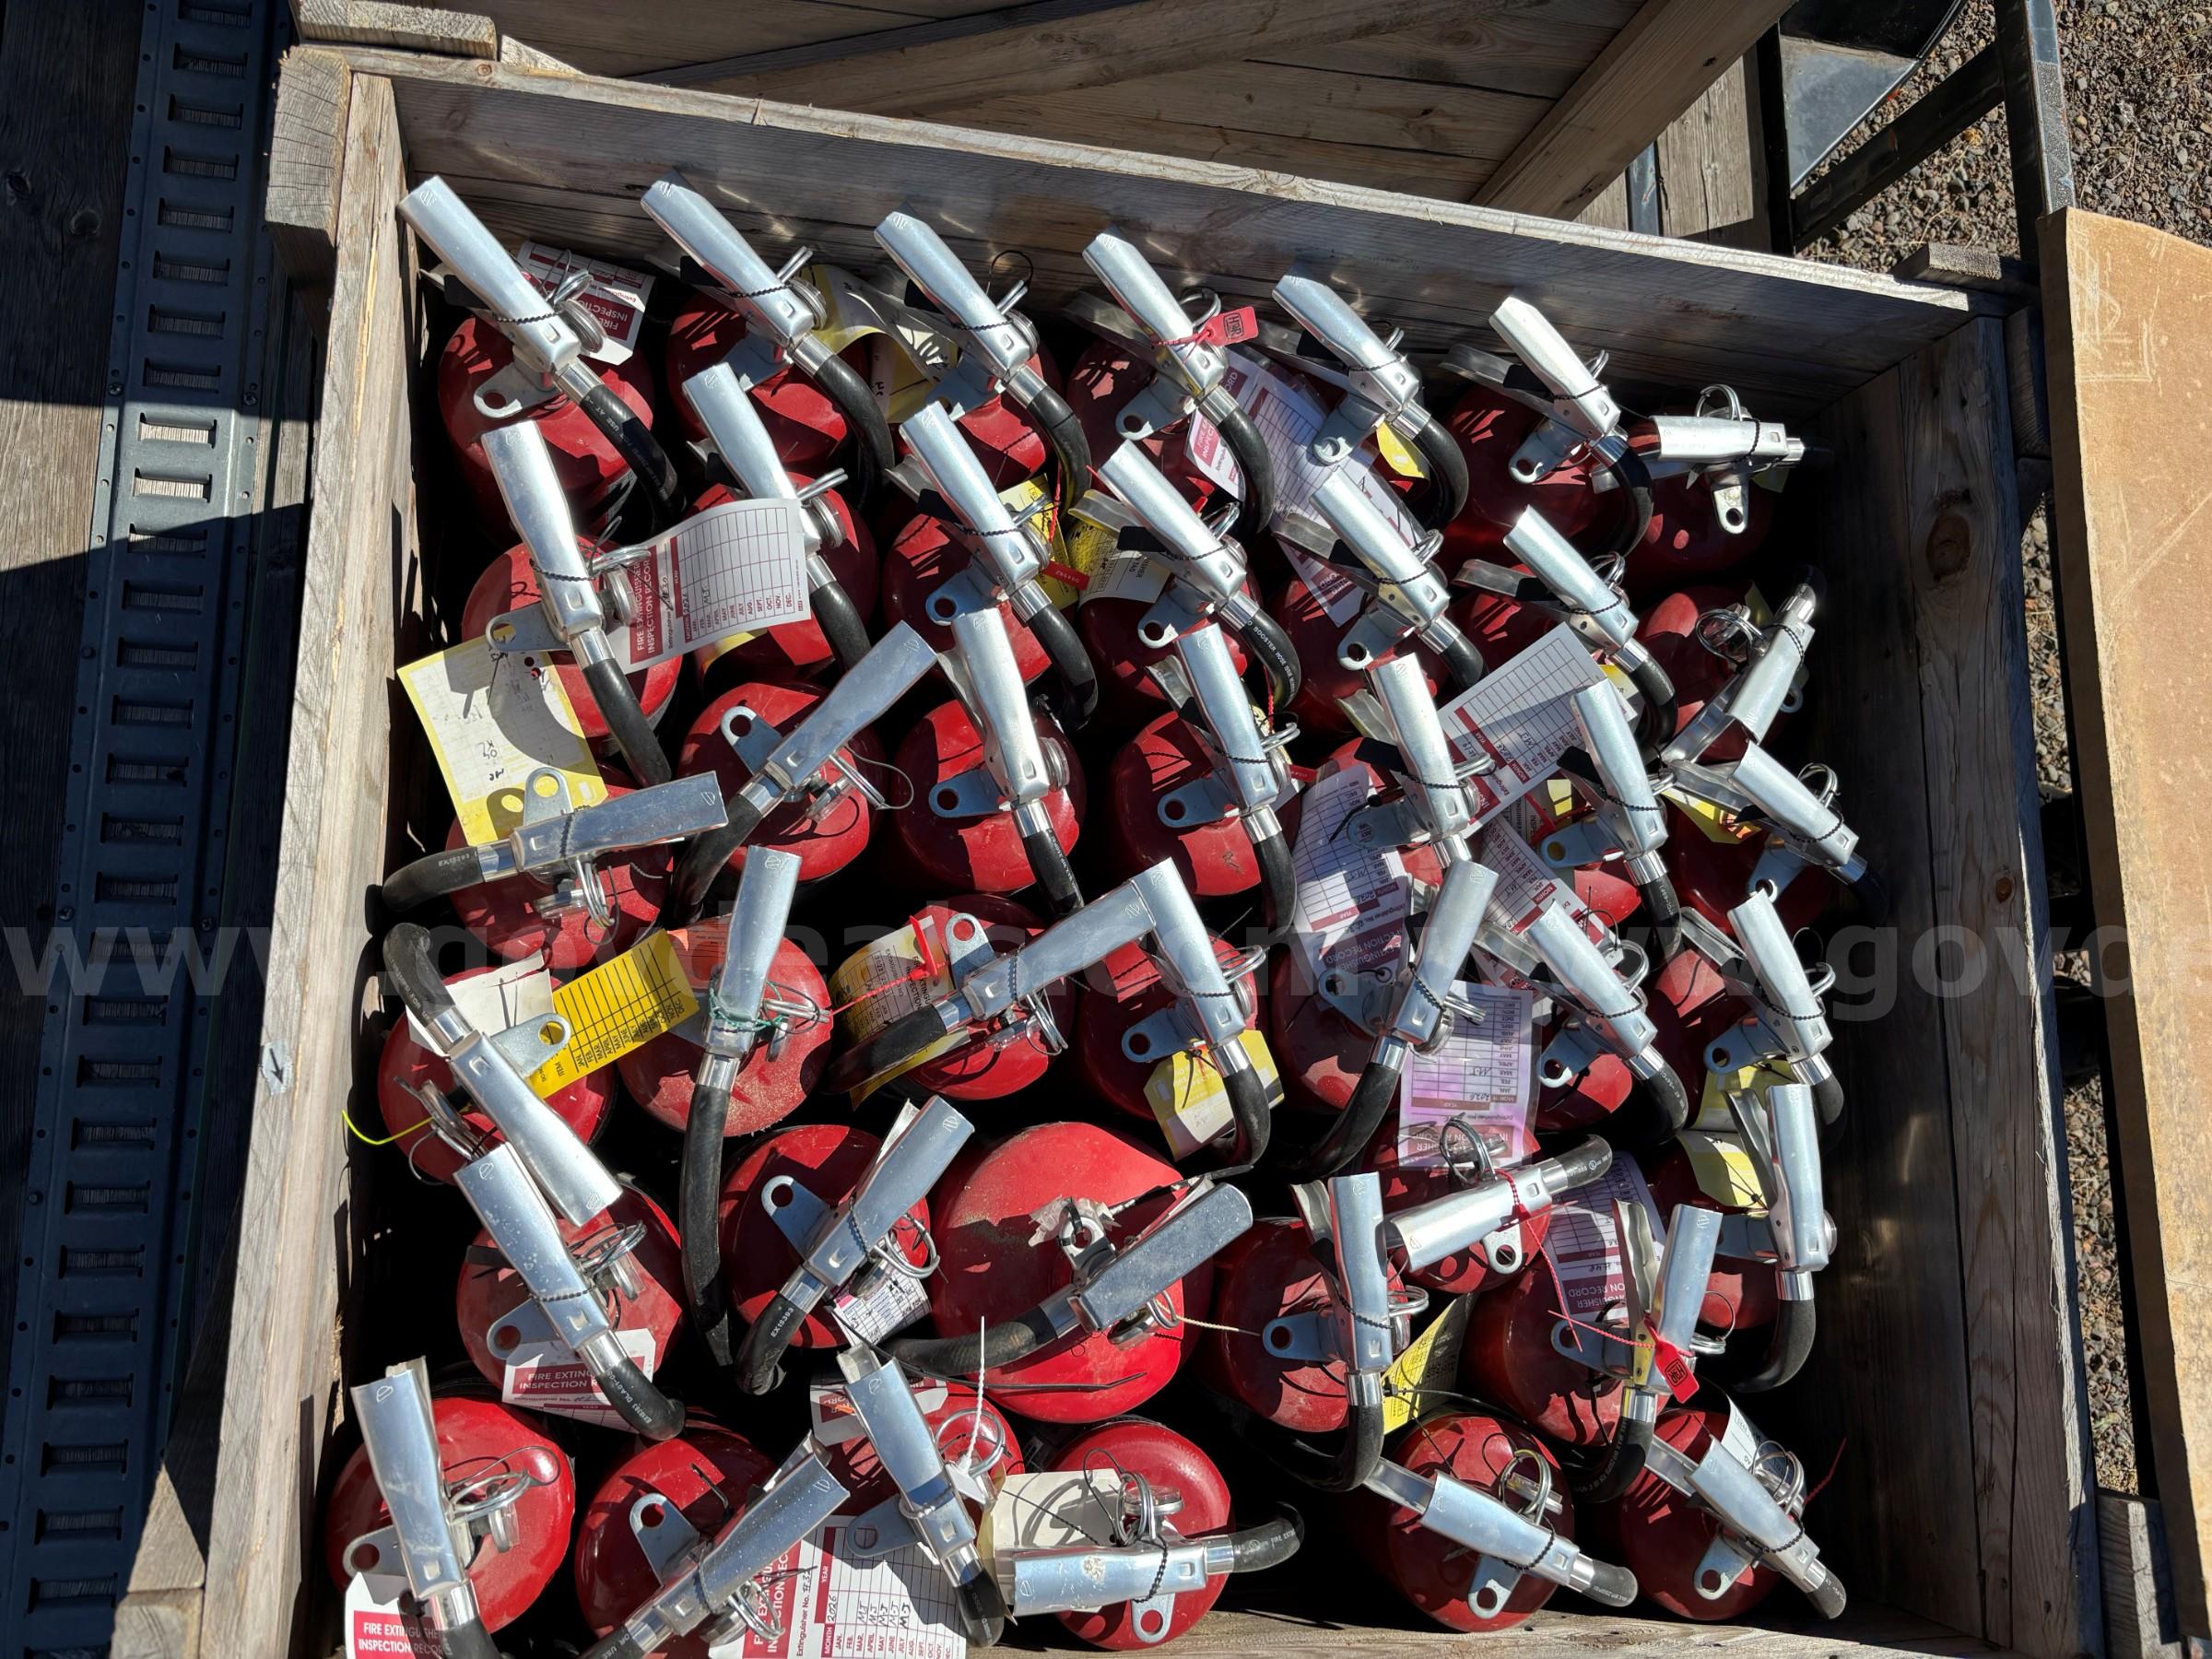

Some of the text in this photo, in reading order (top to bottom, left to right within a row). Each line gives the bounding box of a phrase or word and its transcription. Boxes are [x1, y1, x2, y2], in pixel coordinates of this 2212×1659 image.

[575, 299, 628, 322] INSPECTIO
[642, 559, 655, 653] INSPECTION RECOR
[746, 599, 754, 615] AUG.
[784, 592, 793, 607] DEC.
[635, 630, 646, 651] FIRE
[1252, 625, 1277, 653] BOOSTER
[1567, 1283, 1606, 1298] RECORD
[520, 1379, 587, 1389] INSPECTION
[527, 1370, 592, 1381] FIRE EXTING
[819, 1564, 830, 1583] YEAR
[825, 1594, 839, 1622] 2026
[363, 1622, 439, 1639] FIRE EXTINGUSHE
[795, 1593, 810, 1657] Extinguisher No.
[358, 1638, 443, 1655] INSPECTION RECOR
[822, 1626, 832, 1654] MONTH
[833, 1632, 843, 1650] JAN.
[844, 1633, 853, 1649] FEB.
[854, 1632, 865, 1652] MAR.
[865, 1631, 876, 1653] APRIL
[876, 1635, 886, 1652] MAY
[886, 1635, 896, 1653] JUNE
[896, 1637, 906, 1653] JULY
[906, 1637, 916, 1655] AUG.
[916, 1639, 926, 1656] SEPT.
[925, 1641, 935, 1658] OCT.
